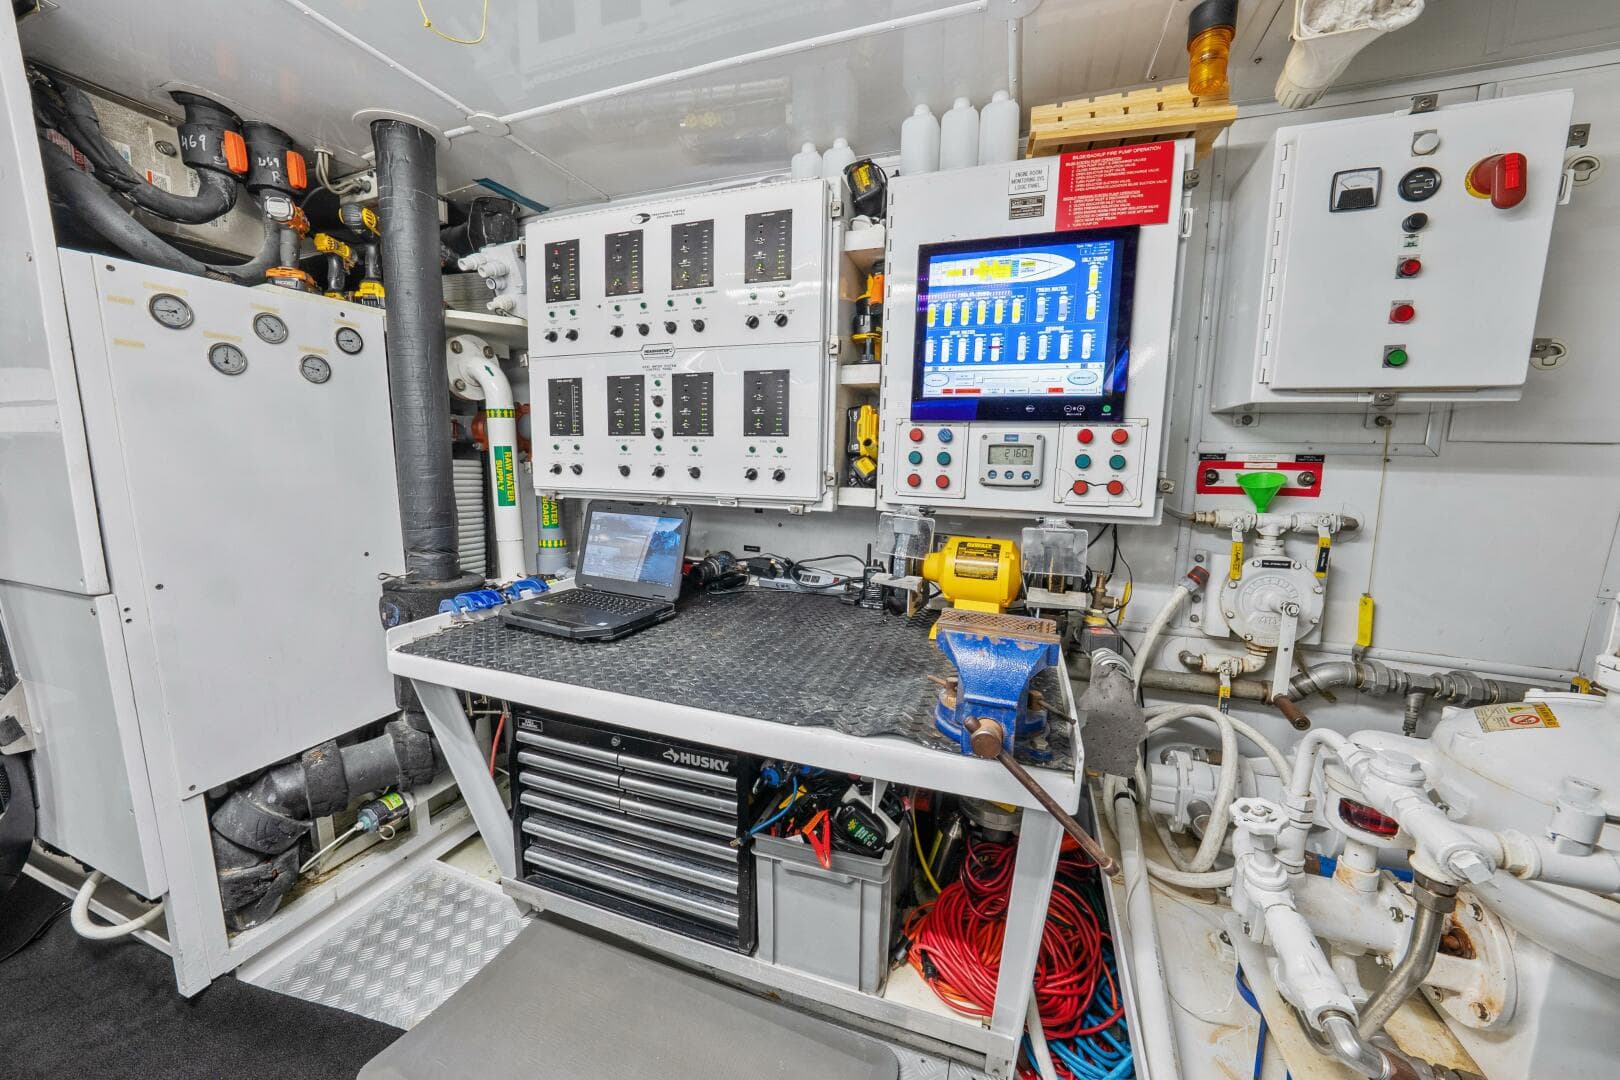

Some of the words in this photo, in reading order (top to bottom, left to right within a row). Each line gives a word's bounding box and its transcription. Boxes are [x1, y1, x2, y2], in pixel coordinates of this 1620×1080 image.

[182, 134, 206, 150] 469
[272, 171, 281, 184] R
[504, 452, 512, 470] RAW
[496, 460, 504, 490] SUPPLY
[506, 473, 514, 502] WATER
[680, 751, 729, 773] HUSKY
